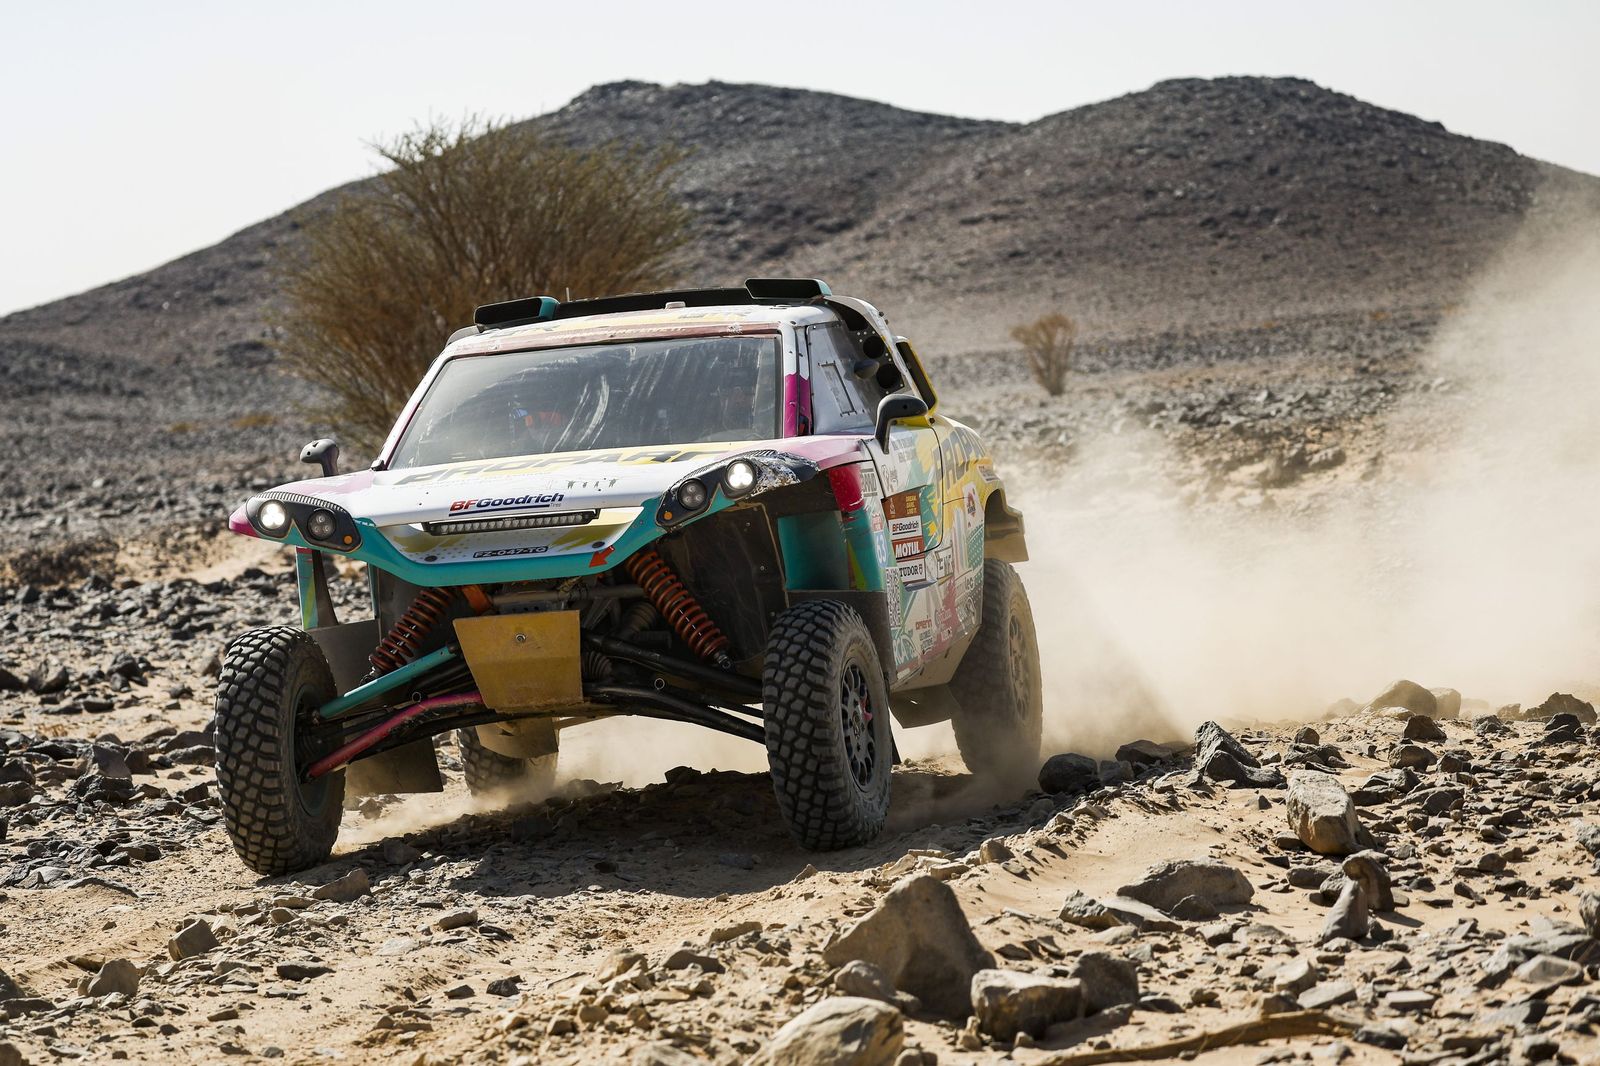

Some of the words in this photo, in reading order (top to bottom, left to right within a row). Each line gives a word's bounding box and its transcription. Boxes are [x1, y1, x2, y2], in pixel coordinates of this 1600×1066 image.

[449, 493, 564, 512] BFGoodrich
[892, 521, 919, 532] BFGoodrich
[895, 542, 920, 558] MOTUL
[899, 565, 918, 578] TUDOR
